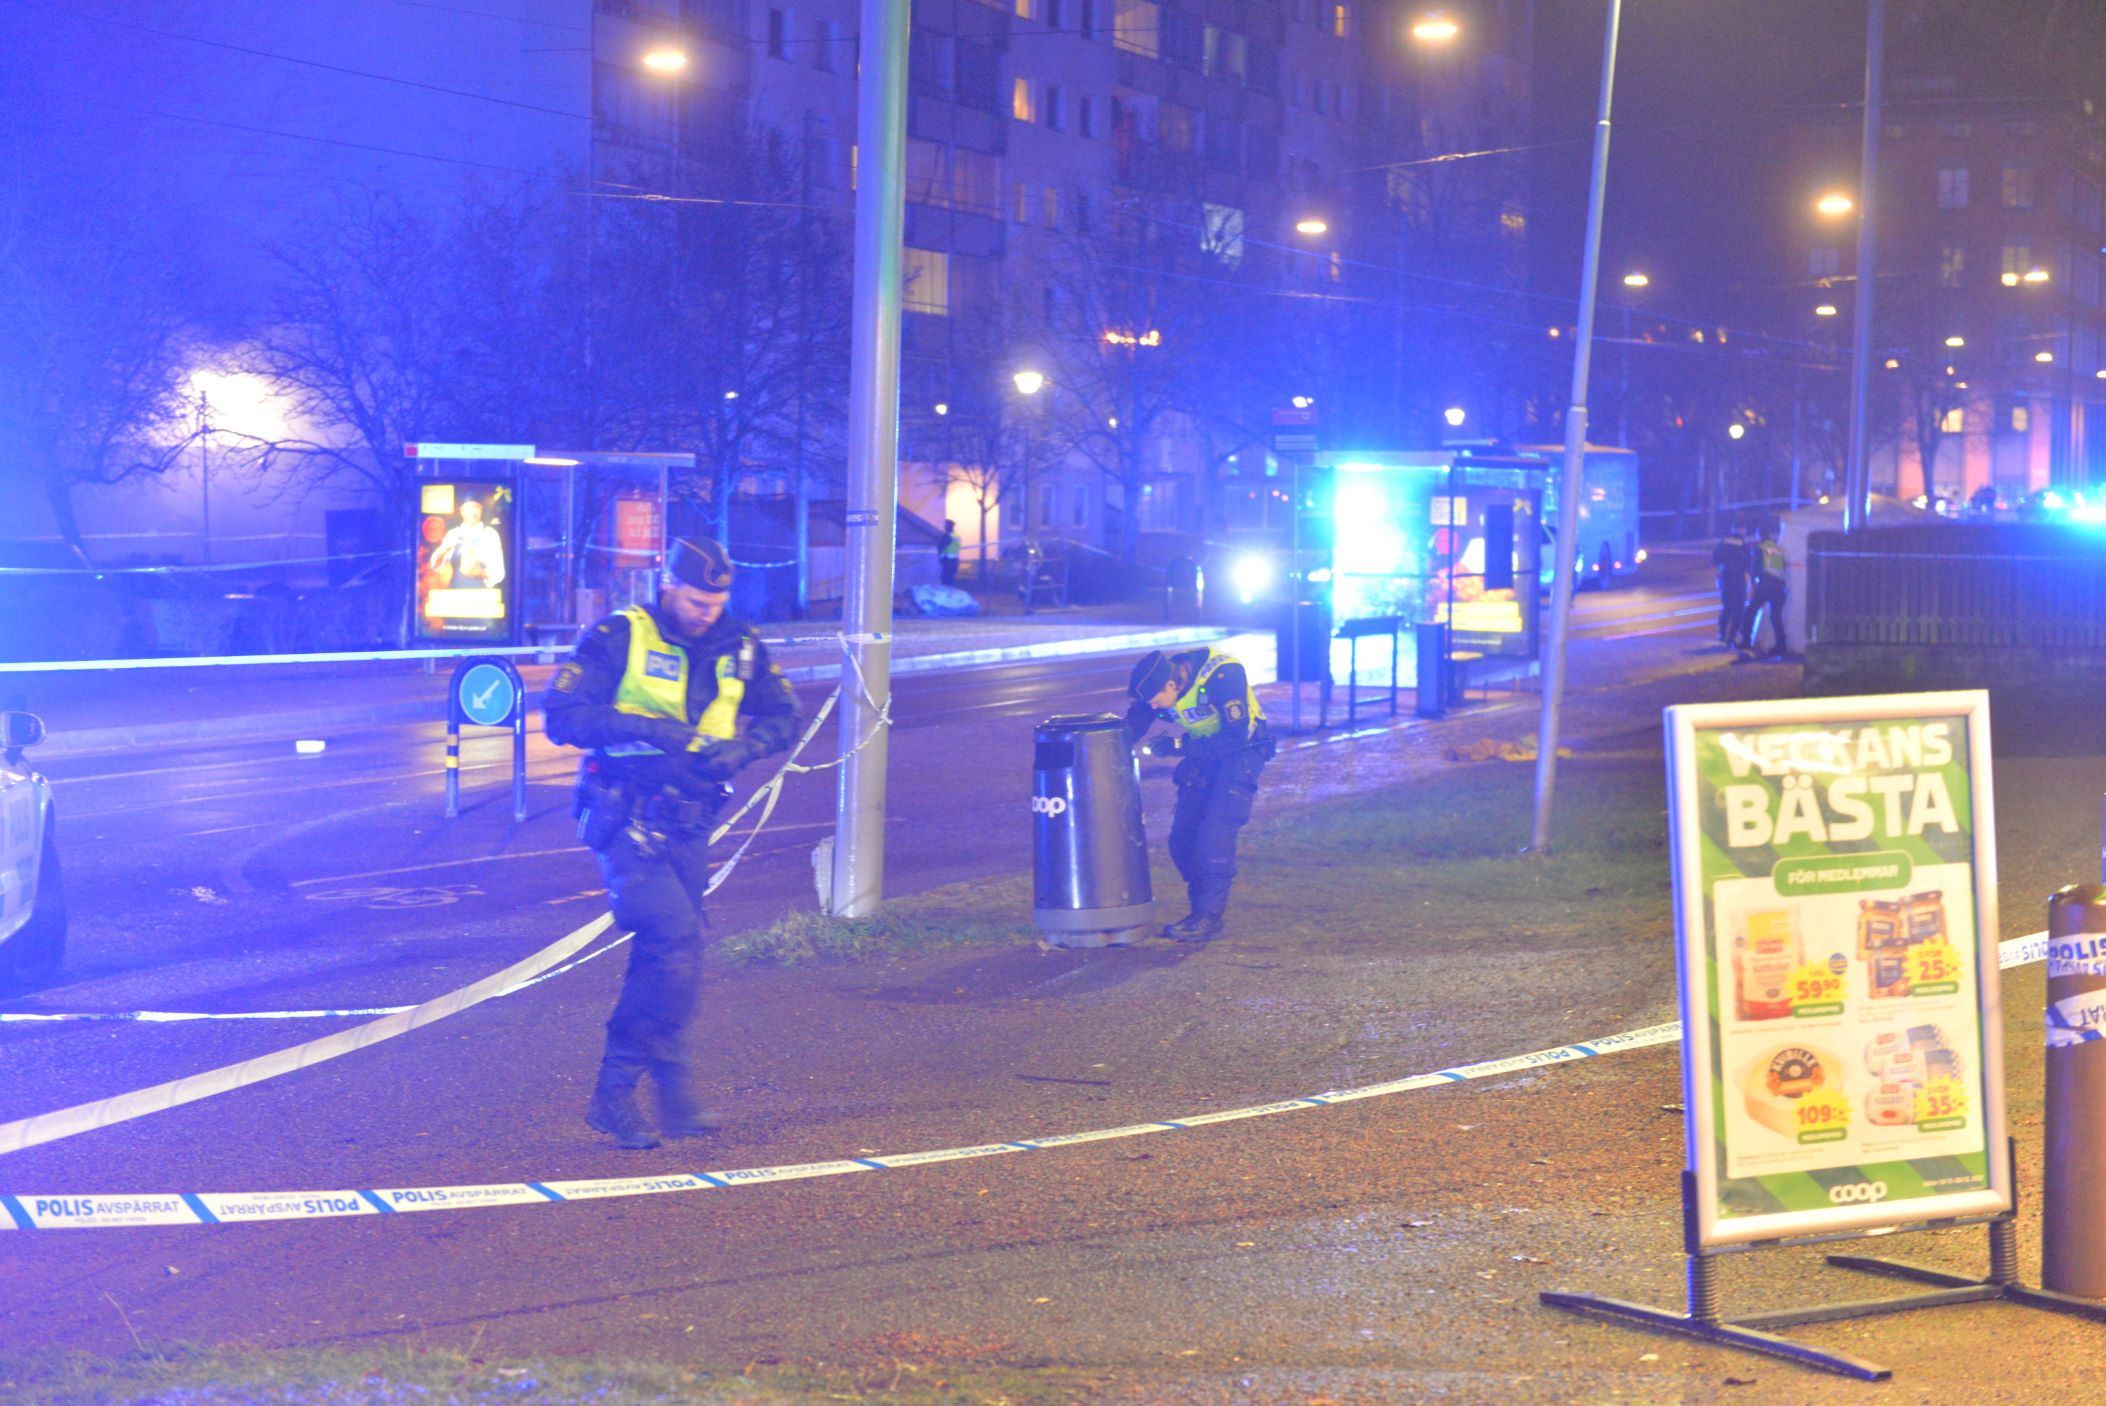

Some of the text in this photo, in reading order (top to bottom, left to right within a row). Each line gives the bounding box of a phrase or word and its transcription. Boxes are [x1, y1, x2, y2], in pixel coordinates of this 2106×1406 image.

[1725, 772, 1959, 847] BÄSTA
[1787, 864, 1899, 885] FÖR MEDLEMMAR
[1525, 1049, 1570, 1064] POLIS
[724, 1169, 776, 1180] POLIS
[644, 1178, 696, 1191] POLIS
[1829, 1181, 1888, 1203] coop
[391, 1190, 447, 1203] POLIS
[36, 1199, 94, 1217] POLIS
[304, 1198, 361, 1214] POLIS
